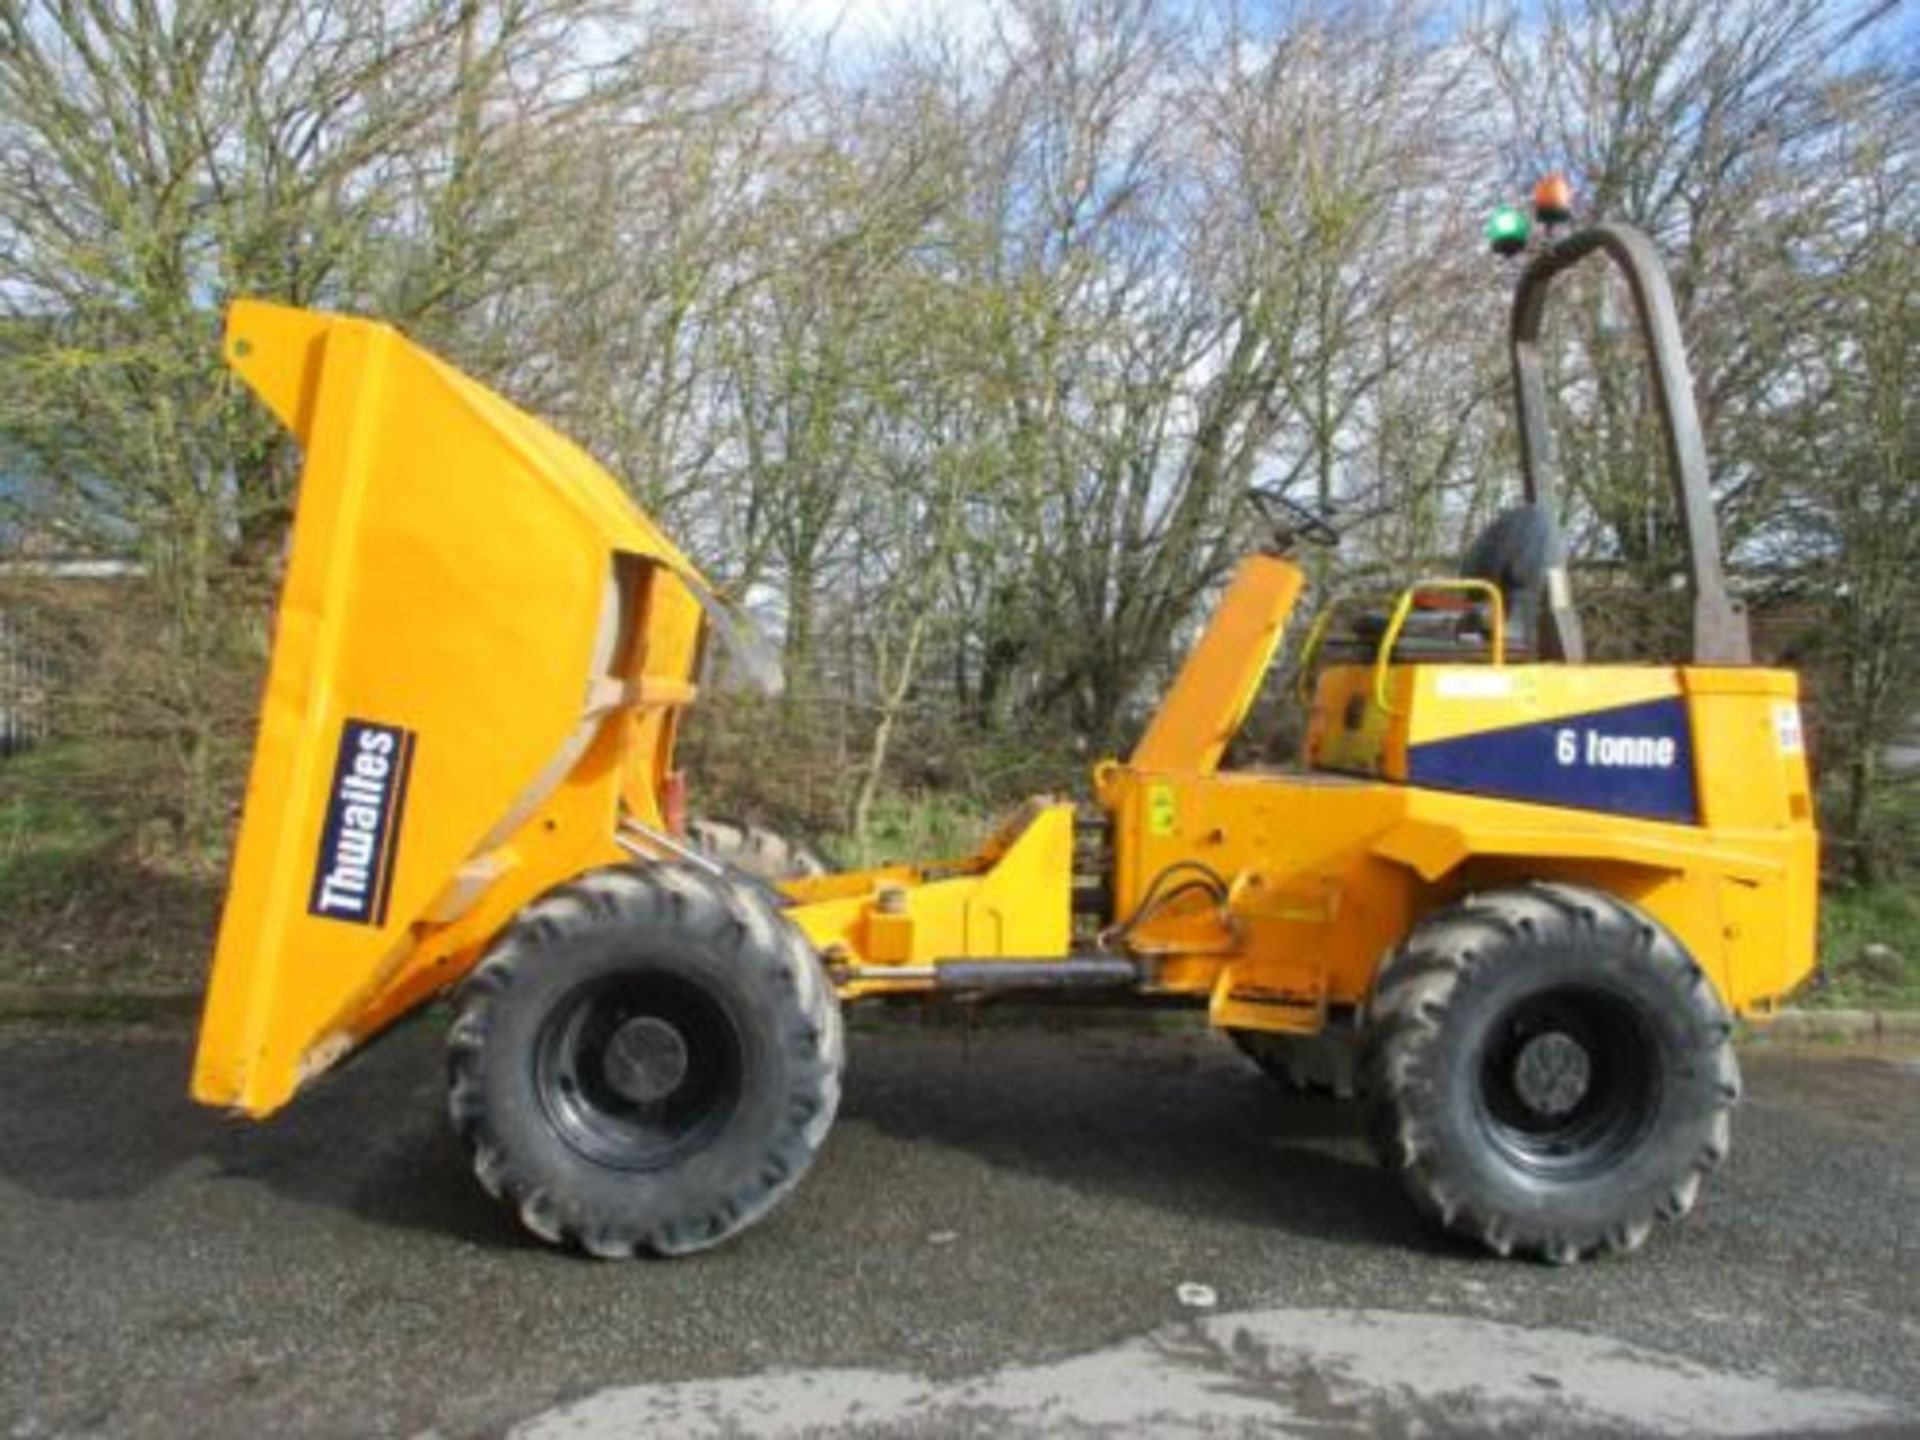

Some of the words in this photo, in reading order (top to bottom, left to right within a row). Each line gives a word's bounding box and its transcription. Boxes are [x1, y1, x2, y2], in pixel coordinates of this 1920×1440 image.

[1557, 729, 1577, 765] 6
[1586, 730, 1675, 767] tonne
[319, 728, 393, 912] Thwaites
